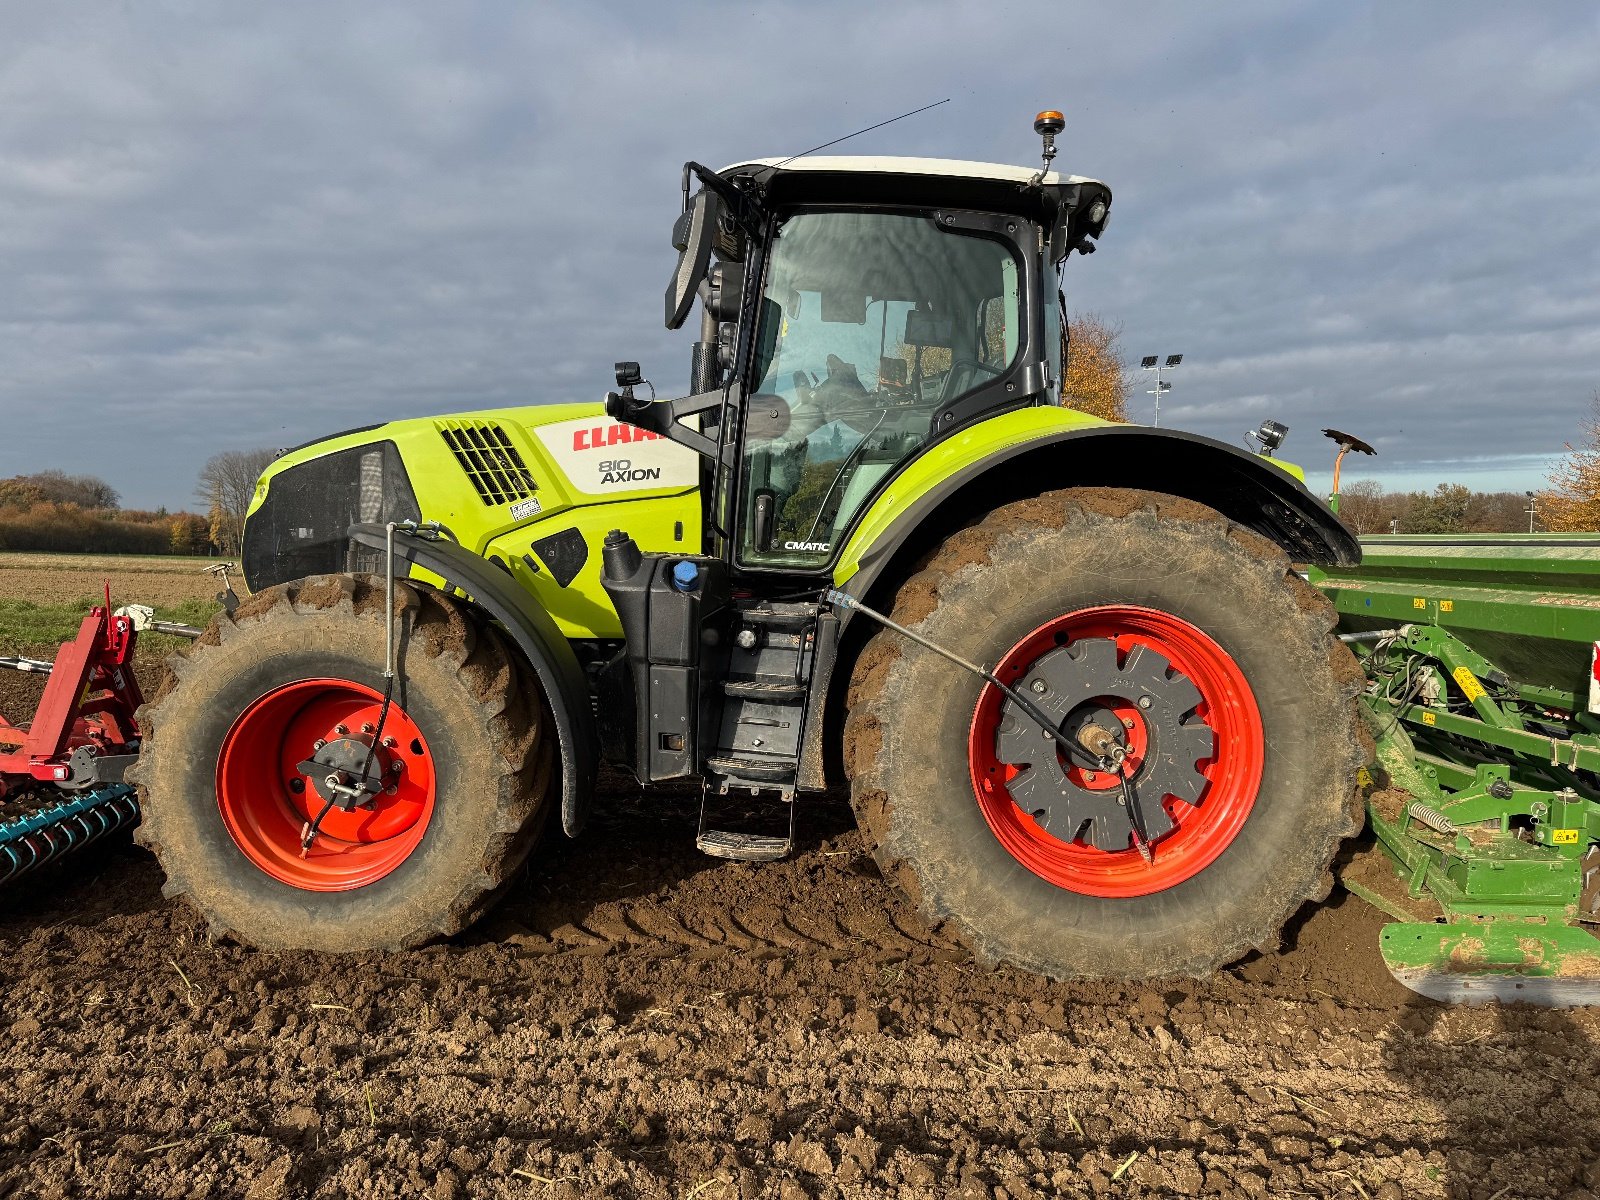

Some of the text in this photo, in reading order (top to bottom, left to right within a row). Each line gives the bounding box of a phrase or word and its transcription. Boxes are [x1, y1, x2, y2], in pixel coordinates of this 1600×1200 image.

[573, 423, 665, 451] CLAA
[598, 459, 631, 472] 810
[600, 467, 660, 484] AXION
[784, 541, 830, 551] CMATIC
